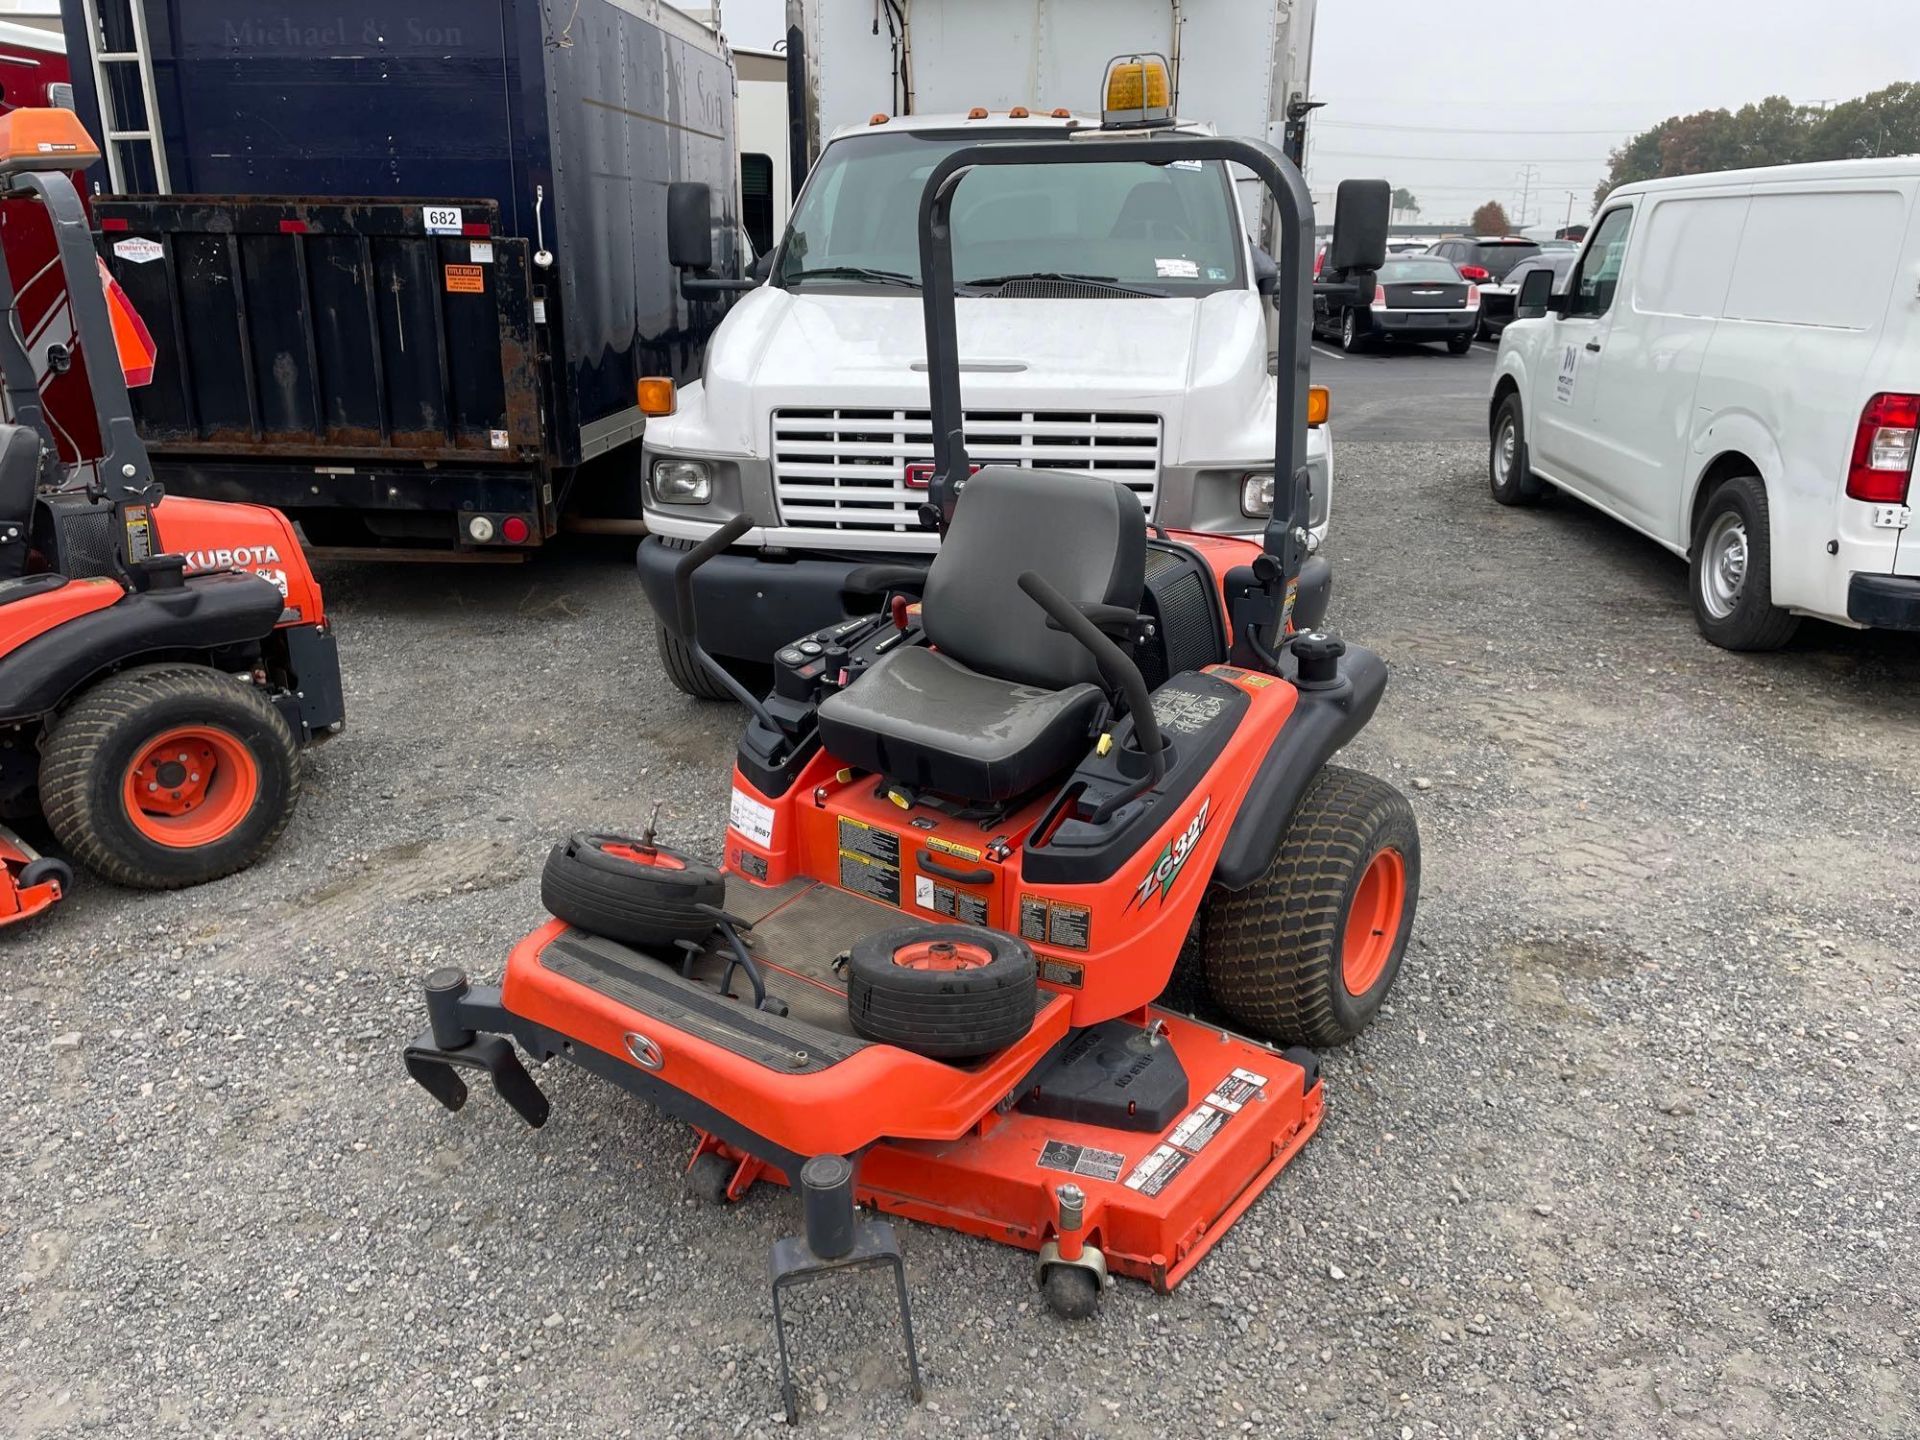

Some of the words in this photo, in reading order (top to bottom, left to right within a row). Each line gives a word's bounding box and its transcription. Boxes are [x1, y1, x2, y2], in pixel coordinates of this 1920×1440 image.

[223, 16, 347, 46] Michael
[362, 17, 392, 46] &
[406, 16, 463, 46] Son
[430, 211, 457, 225] 682
[448, 267, 461, 275] TITLE
[179, 545, 280, 570] KUBOTA
[1137, 795, 1211, 908] ZG327
